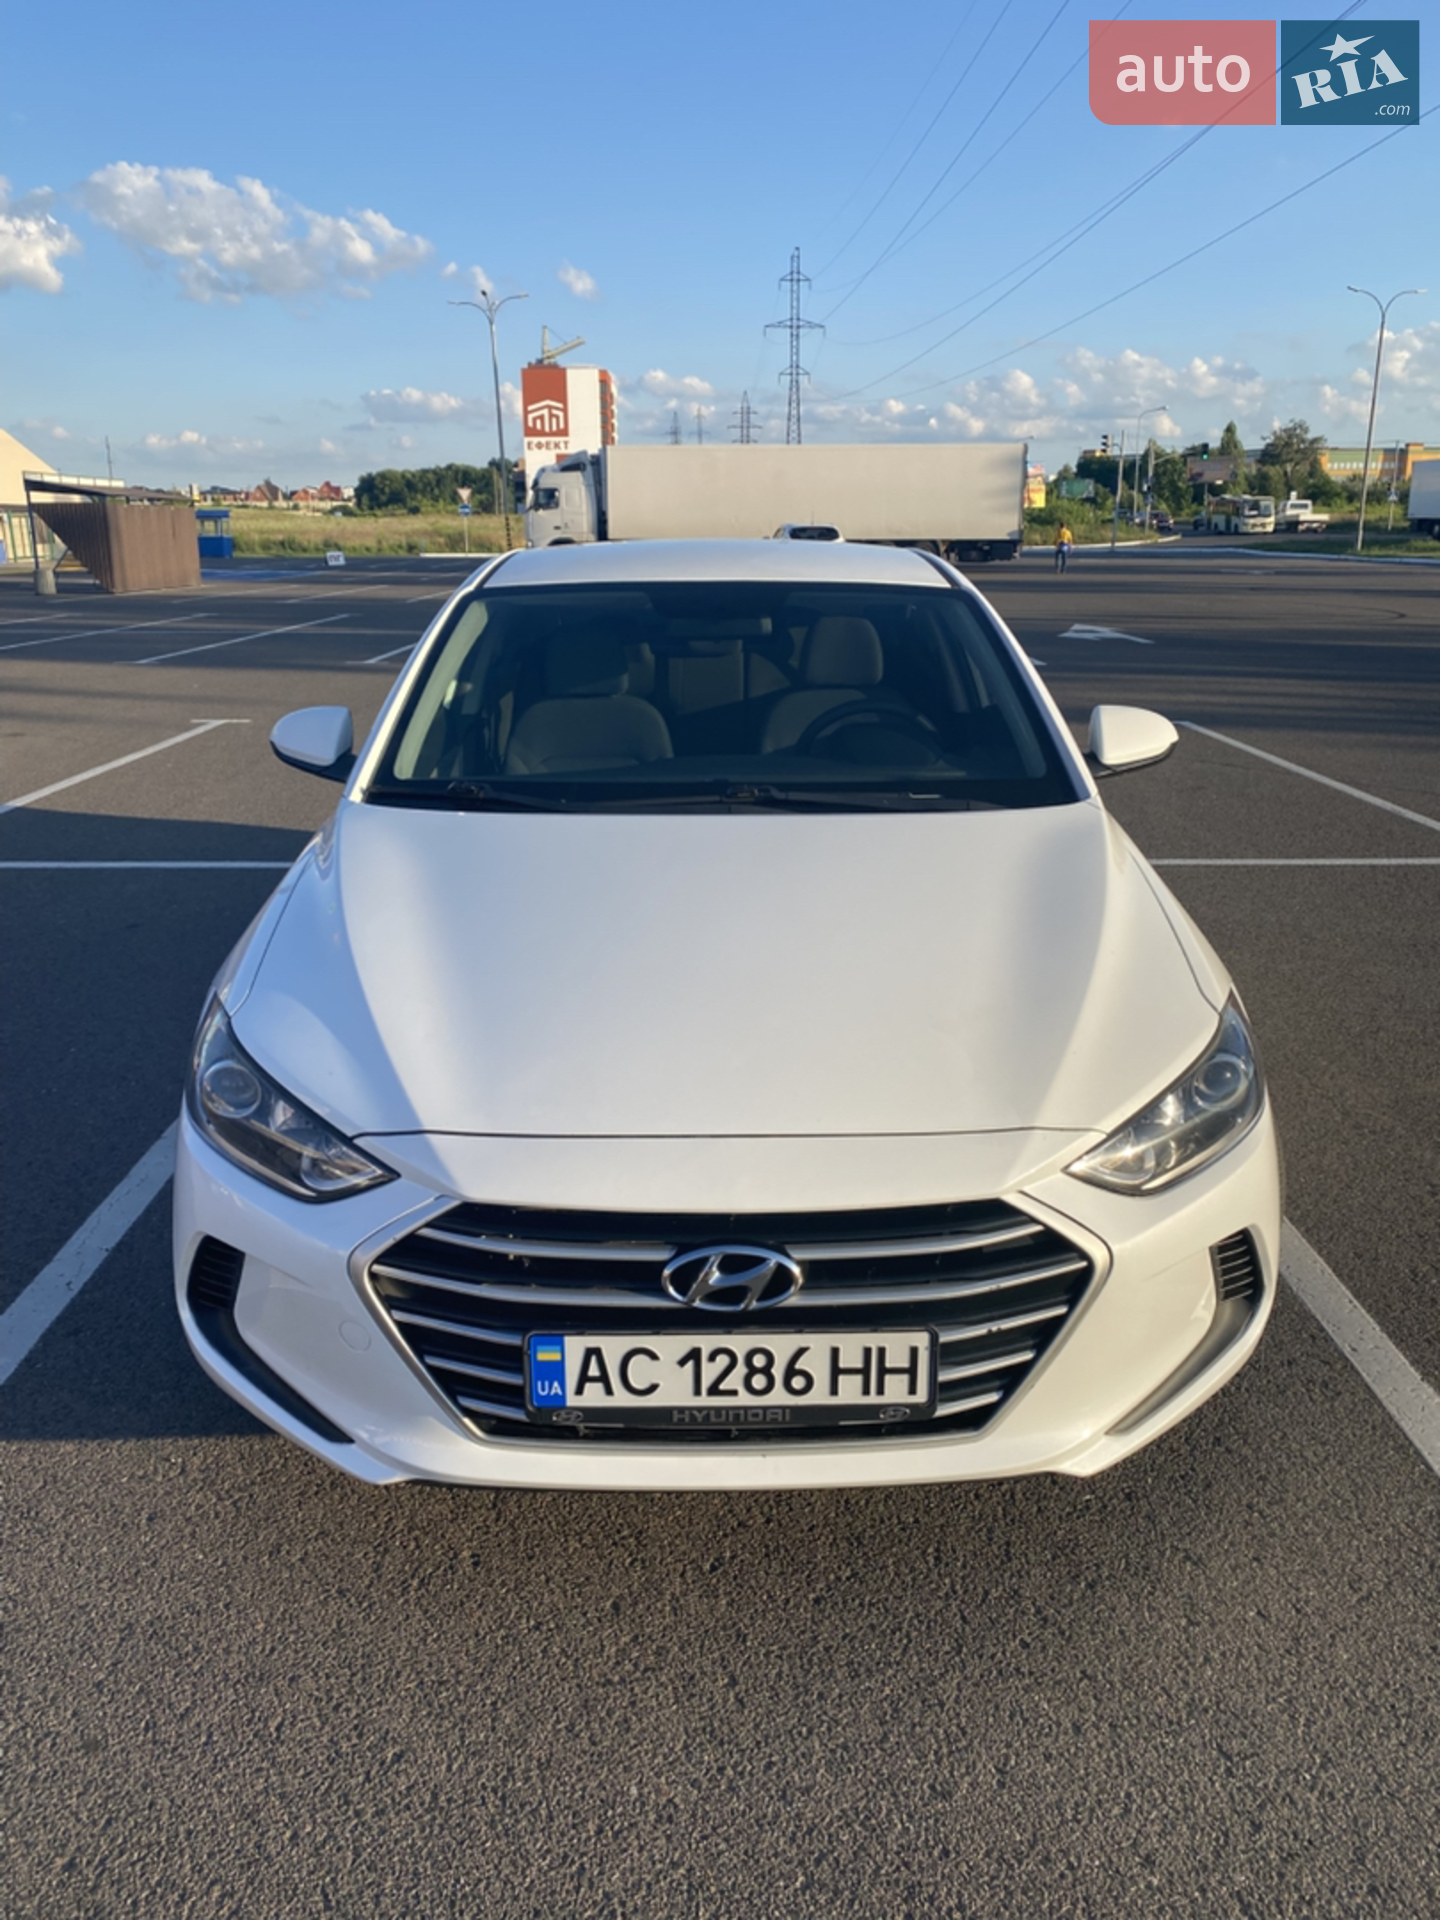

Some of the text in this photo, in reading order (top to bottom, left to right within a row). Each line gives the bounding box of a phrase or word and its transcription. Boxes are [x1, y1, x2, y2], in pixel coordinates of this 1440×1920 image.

[527, 440, 570, 451] ЕФЕКТ
[574, 1346, 919, 1397] AC 1286 HH
[536, 1380, 563, 1396] UA
[672, 1408, 791, 1423] HYUNDAI
